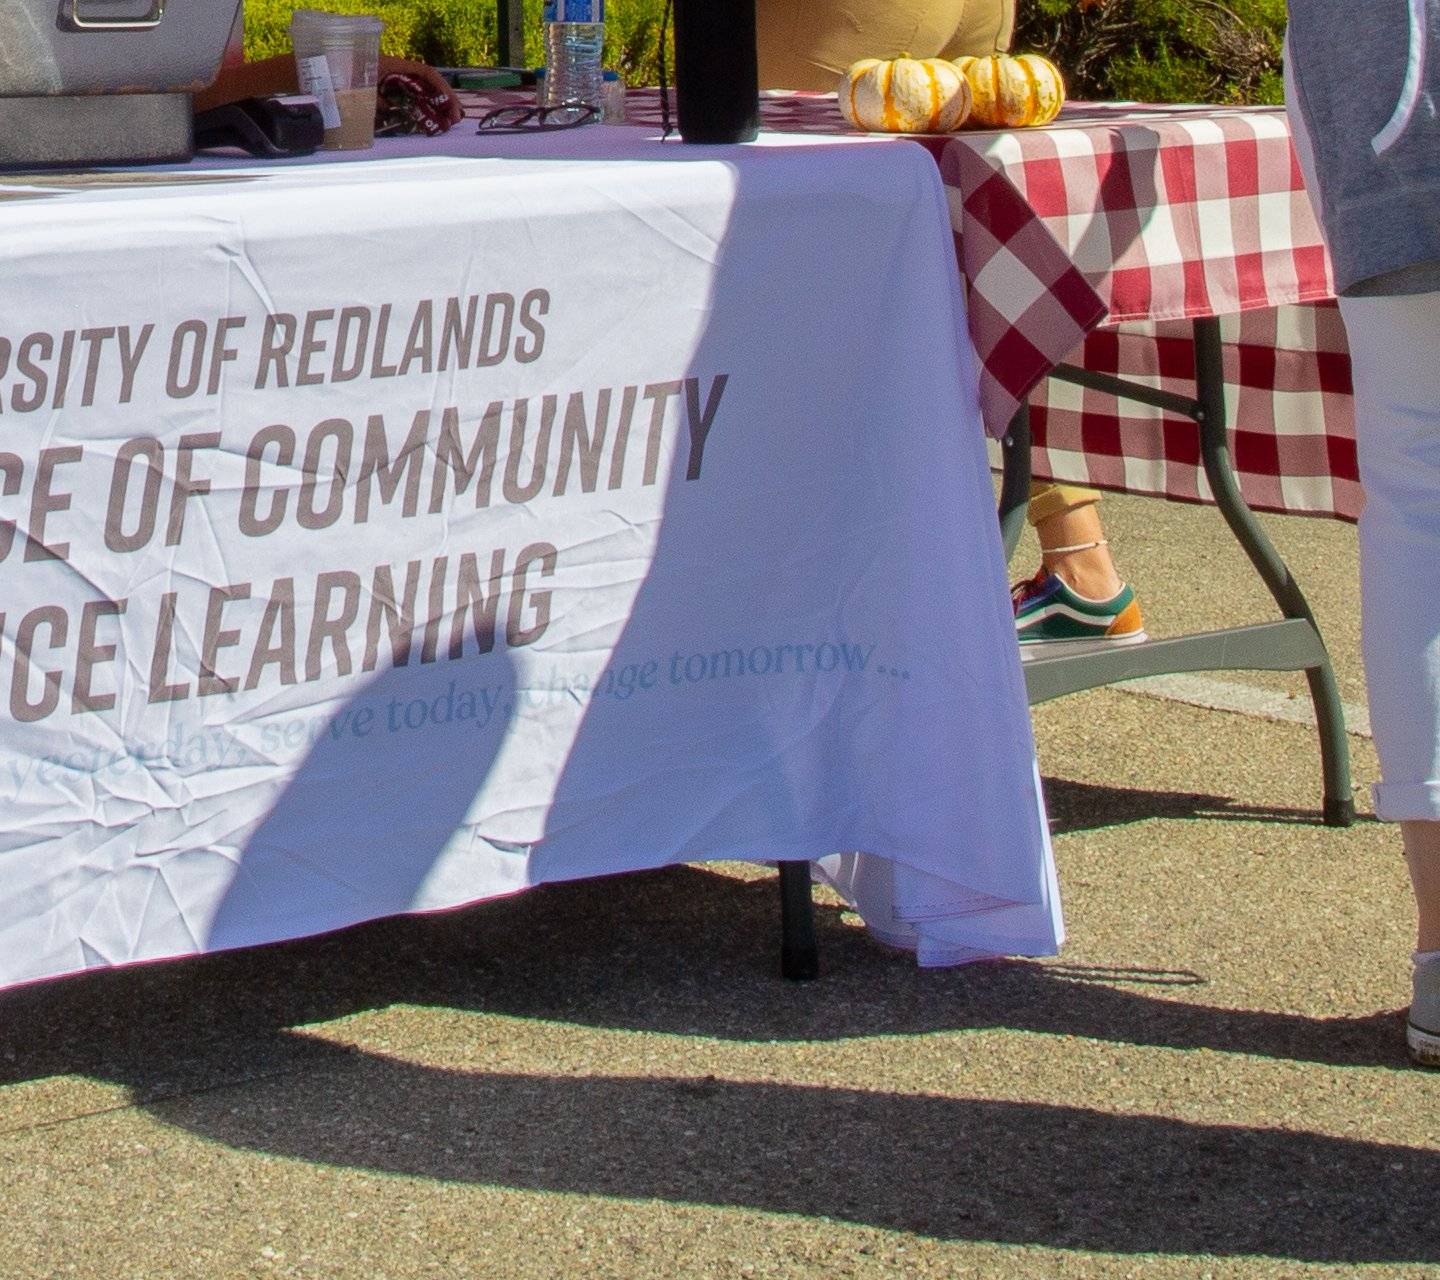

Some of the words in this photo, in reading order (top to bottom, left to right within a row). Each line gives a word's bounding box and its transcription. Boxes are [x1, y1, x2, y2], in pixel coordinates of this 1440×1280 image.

[164, 315, 246, 399] OF
[253, 287, 551, 390] REDLANDS
[103, 431, 221, 556] OF
[237, 373, 729, 539] COMMUNITY
[147, 540, 558, 707] LEARNING
[259, 703, 373, 753] serve
[386, 678, 517, 736] today,
[522, 657, 658, 708] change
